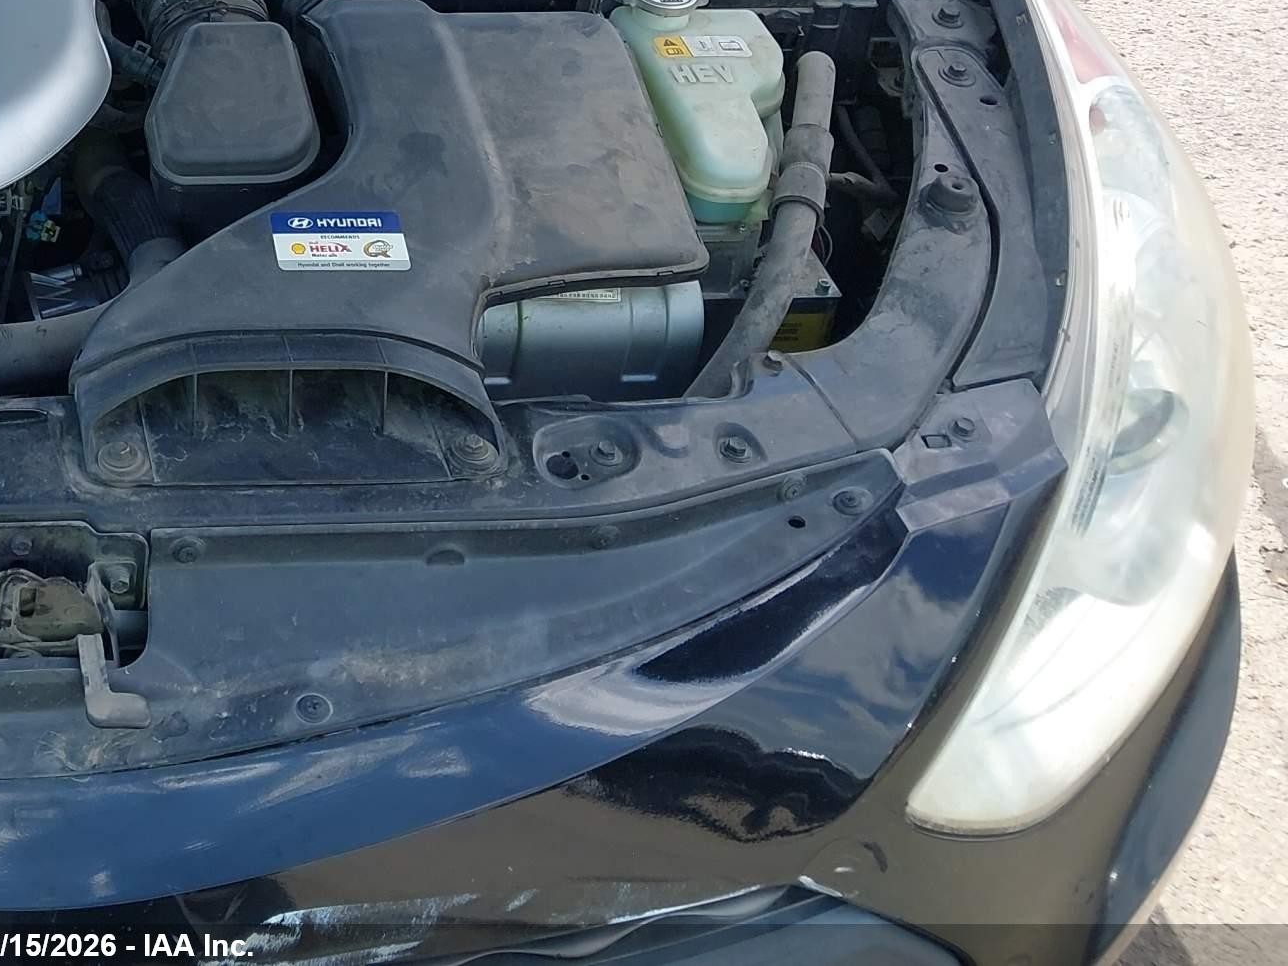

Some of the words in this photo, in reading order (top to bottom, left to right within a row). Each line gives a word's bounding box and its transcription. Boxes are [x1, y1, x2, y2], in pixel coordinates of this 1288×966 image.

[669, 64, 734, 84] HEV
[316, 217, 382, 227] HYUNDAI
[310, 245, 352, 253] HELIX
